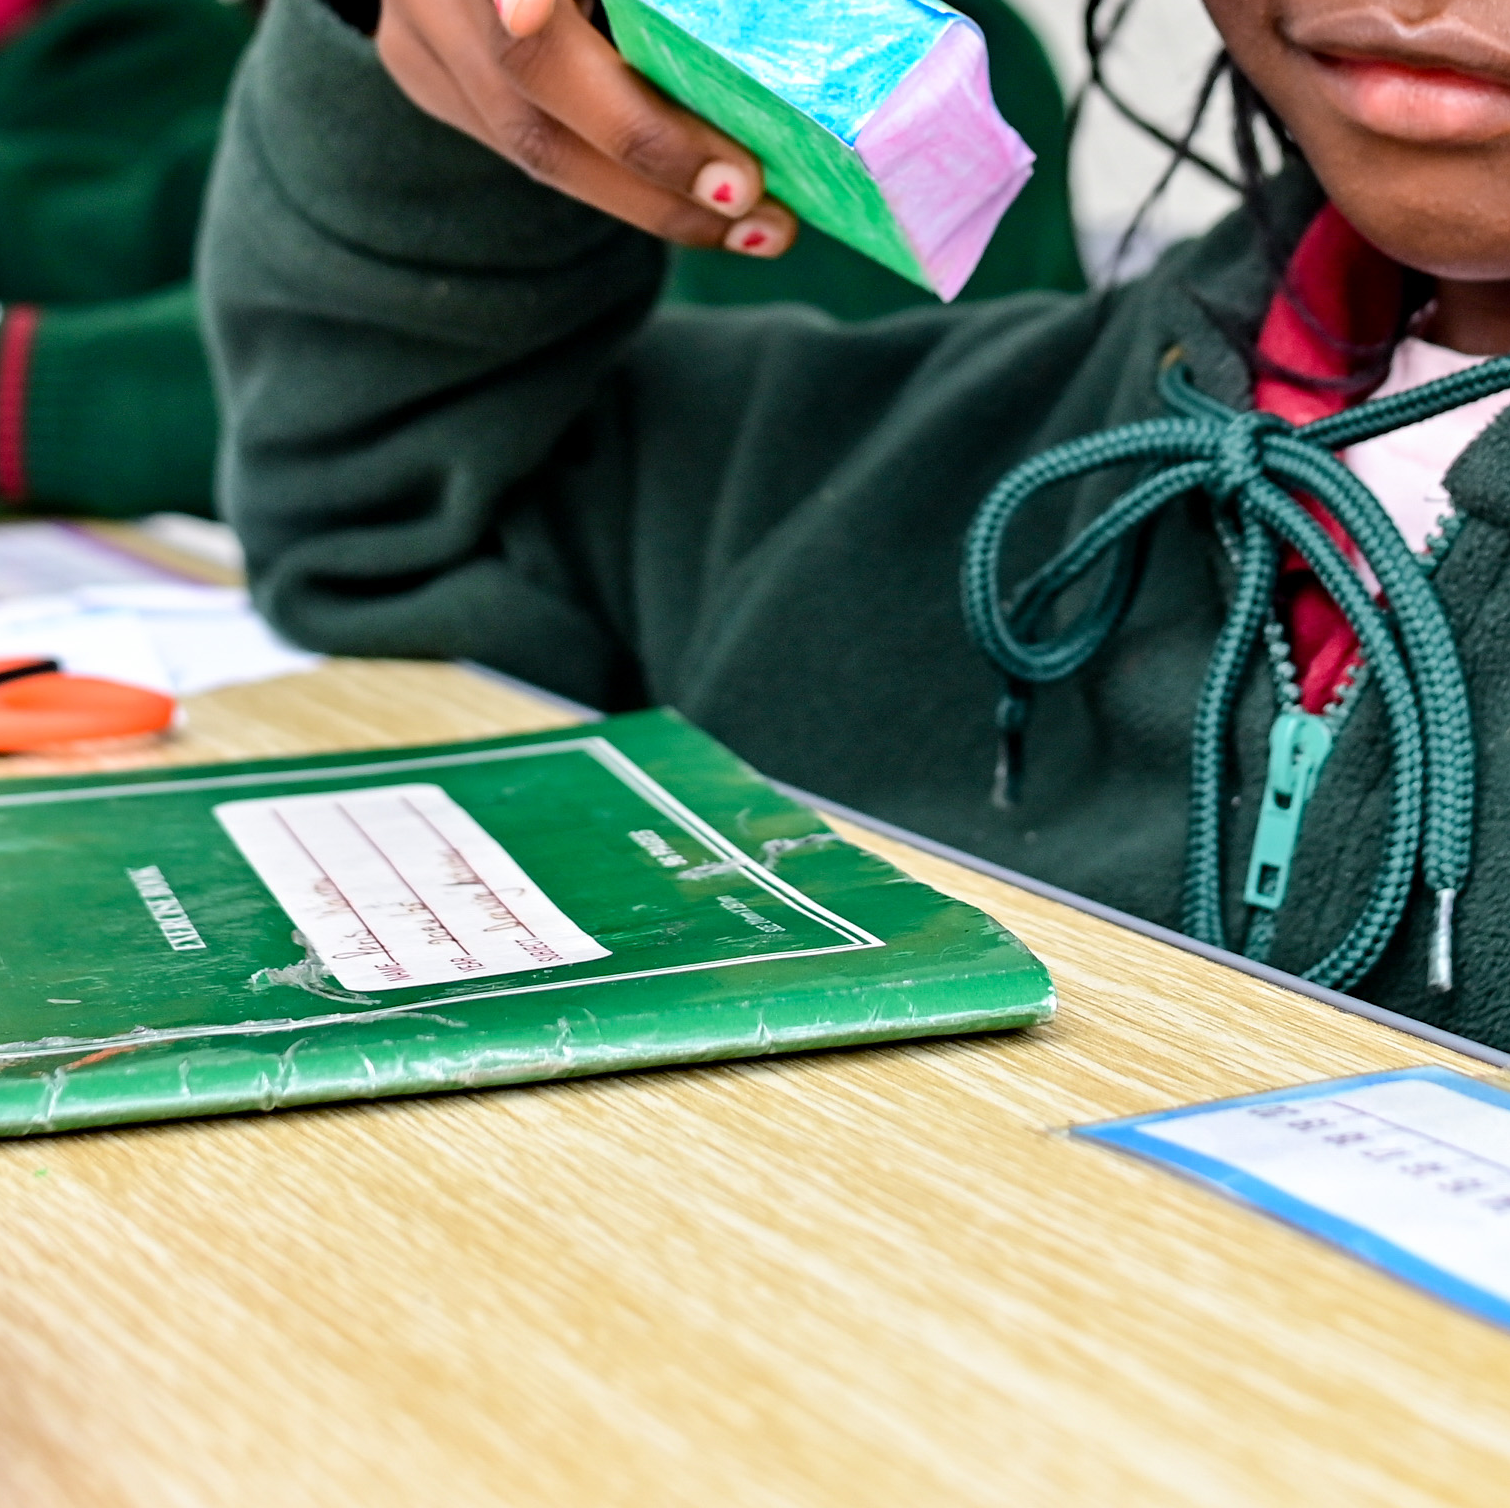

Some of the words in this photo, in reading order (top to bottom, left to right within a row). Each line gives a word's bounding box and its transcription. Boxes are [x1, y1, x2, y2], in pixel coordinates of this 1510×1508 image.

[144, 895, 208, 952] EXERCISE
[331, 928, 392, 960] Peris
[514, 938, 564, 962] SUBJECT
[373, 963, 414, 982] NAME
[450, 956, 487, 973] YEAR
